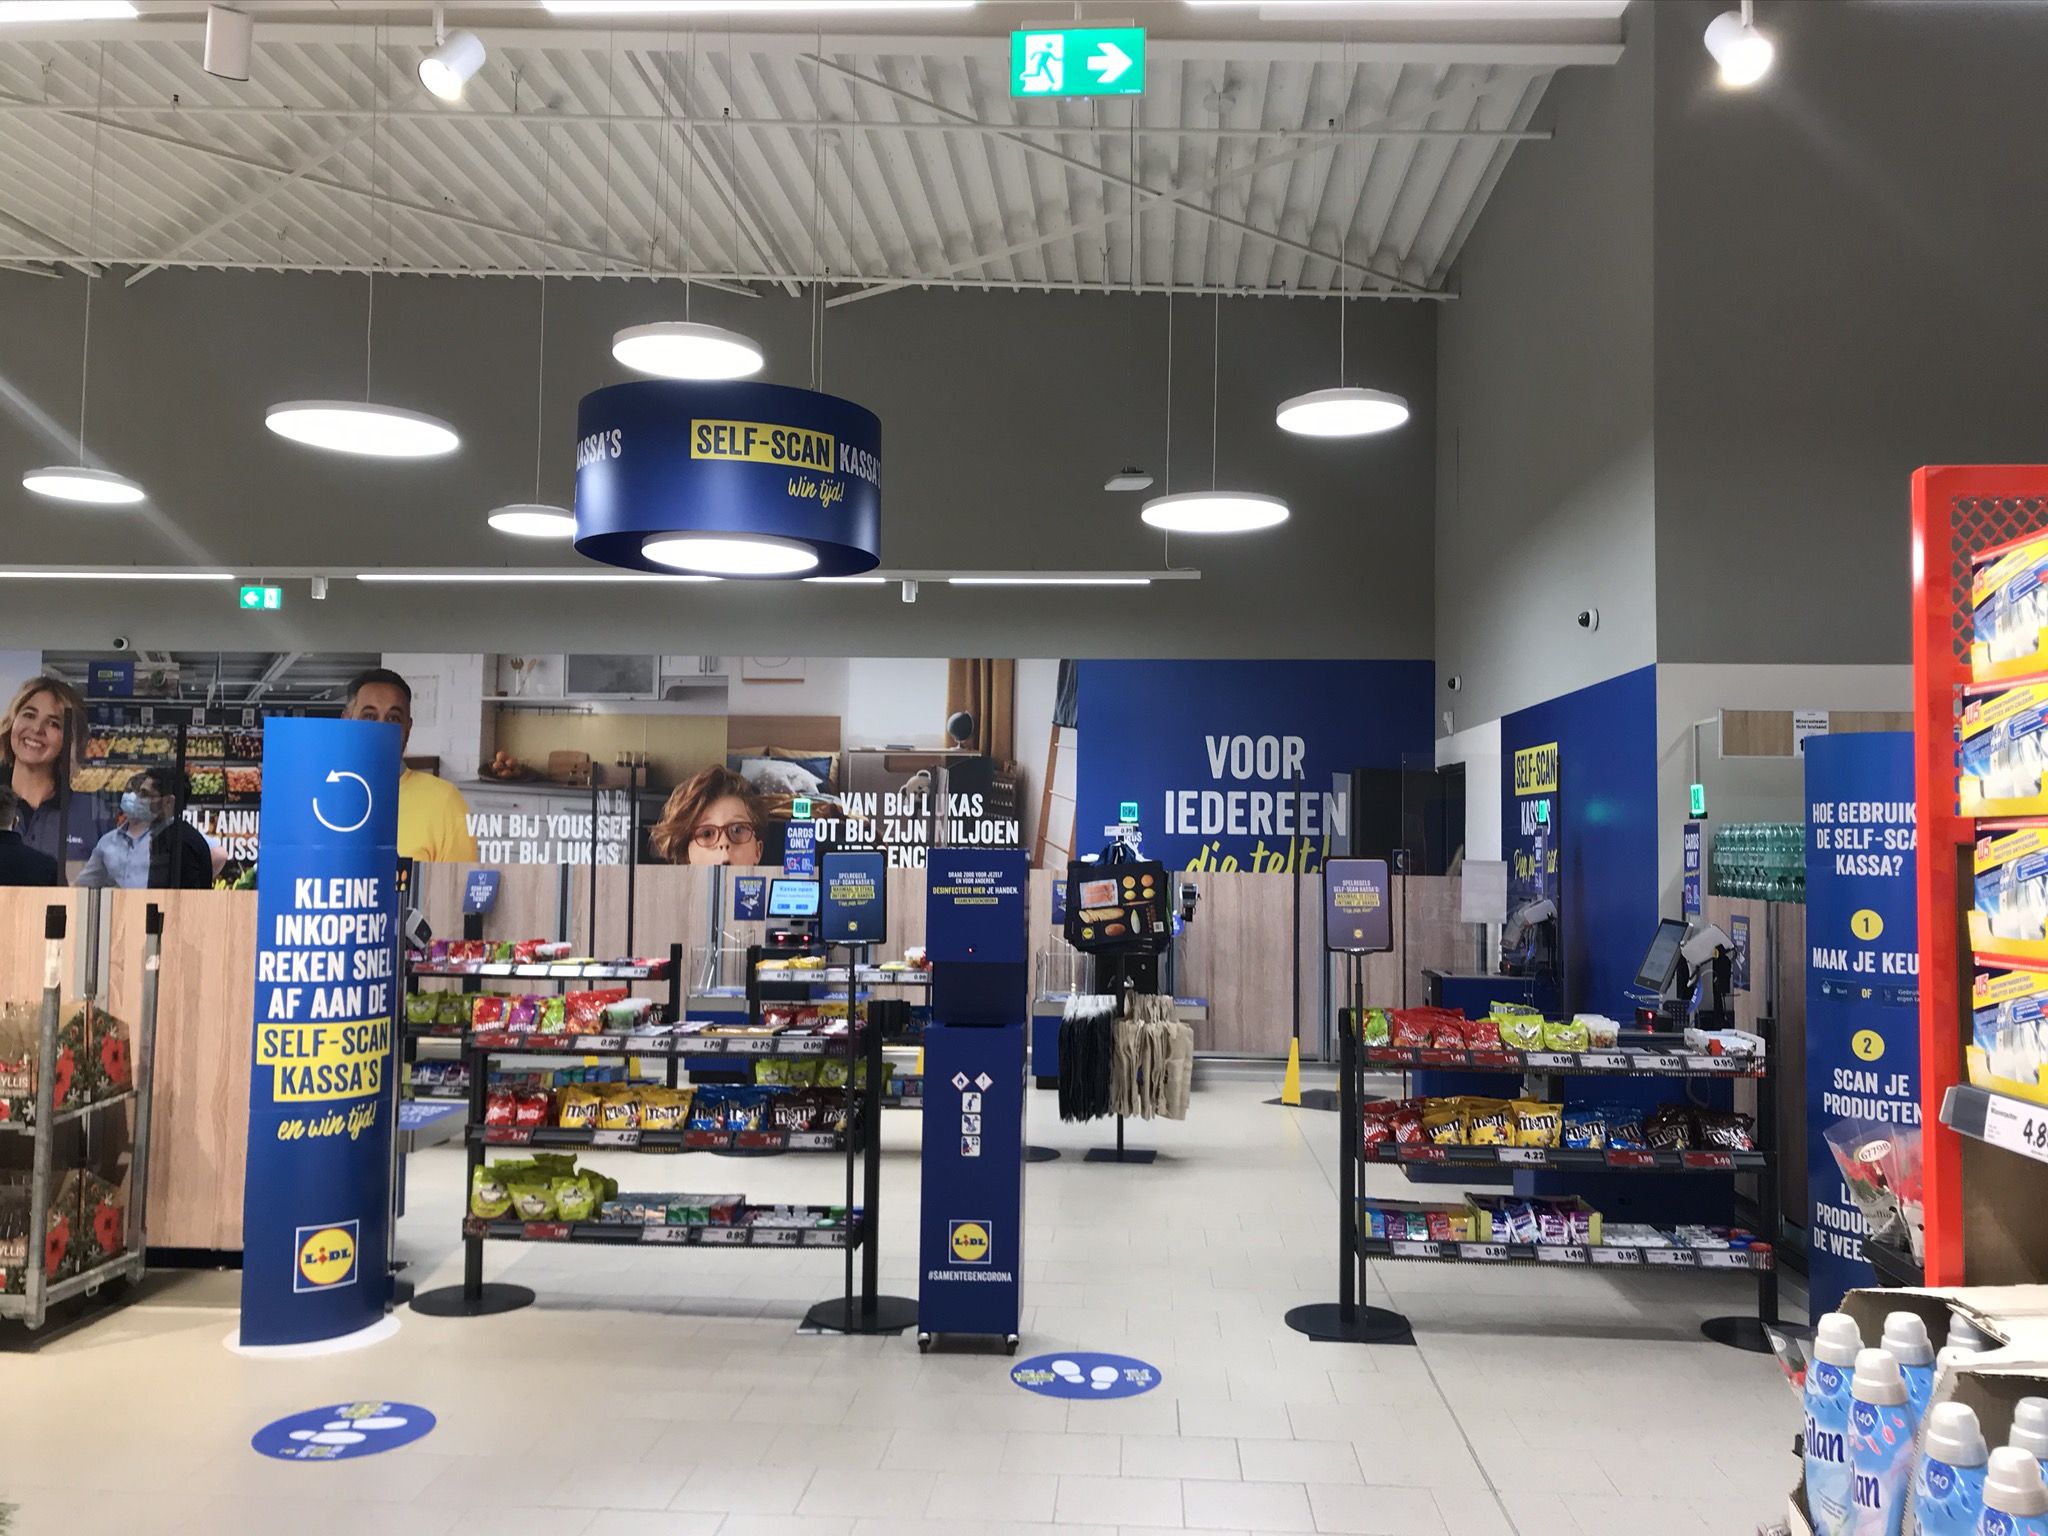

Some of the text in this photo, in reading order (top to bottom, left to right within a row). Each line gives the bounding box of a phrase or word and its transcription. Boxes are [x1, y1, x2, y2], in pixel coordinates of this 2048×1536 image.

[696, 424, 831, 468] SELF-SCAN
[788, 476, 844, 507] Win tijd!
[1205, 735, 1306, 780] VOOR
[1516, 749, 1556, 789] SELF-SCAN
[840, 792, 878, 816] VAN
[884, 793, 915, 817] BIJ
[1165, 790, 1347, 836] IEDEREEN
[1812, 802, 1834, 824] HOE
[465, 814, 631, 841] VAN BIJ YOUSSEF
[787, 827, 814, 838] CARDS
[845, 819, 876, 843] BIJ
[882, 819, 927, 843] ZIJN
[1817, 828, 1830, 849] DE
[477, 841, 620, 865] TOT BIJ LUKAS
[790, 838, 810, 849] ONLY
[1836, 854, 1903, 877] KASSA?
[295, 877, 379, 909] KLEINE
[932, 886, 1019, 895] DESINFECTEER HIER JE HANDEN.
[275, 912, 387, 946] INKOPEN?
[1863, 916, 1870, 933] 1
[258, 948, 392, 983] REKEN SNEL
[1812, 947, 1848, 971] MAAK
[1853, 950, 1877, 974] JE
[267, 983, 387, 1019] AF AAN DE
[1861, 988, 1873, 999] OF
[263, 1021, 388, 1058] SELF-SCAN
[652, 1039, 670, 1048] 1.49
[1863, 1037, 1872, 1054] 2
[1397, 1052, 1413, 1061] 1.49
[1553, 1055, 1573, 1064] 0.99
[1607, 1056, 1626, 1065] 1.49
[1660, 1057, 1680, 1067] 0.99
[280, 1059, 379, 1095] KASSA'S
[1833, 1068, 1909, 1097] SCAN JE
[277, 1120, 306, 1140] en
[308, 1110, 346, 1138] win
[347, 1100, 377, 1141] tijd!
[618, 1133, 638, 1142] 4.22
[2023, 1118, 2048, 1148] 4.8
[1524, 1151, 1544, 1160] 4.22
[1813, 1227, 1827, 1252] DE
[1565, 1249, 1583, 1259] 1.49
[928, 1270, 1012, 1282] #SAMENTEGENCORONA
[1818, 1371, 1838, 1389] 140
[1855, 1410, 1873, 1427] 140
[1929, 1470, 1949, 1489] 140
